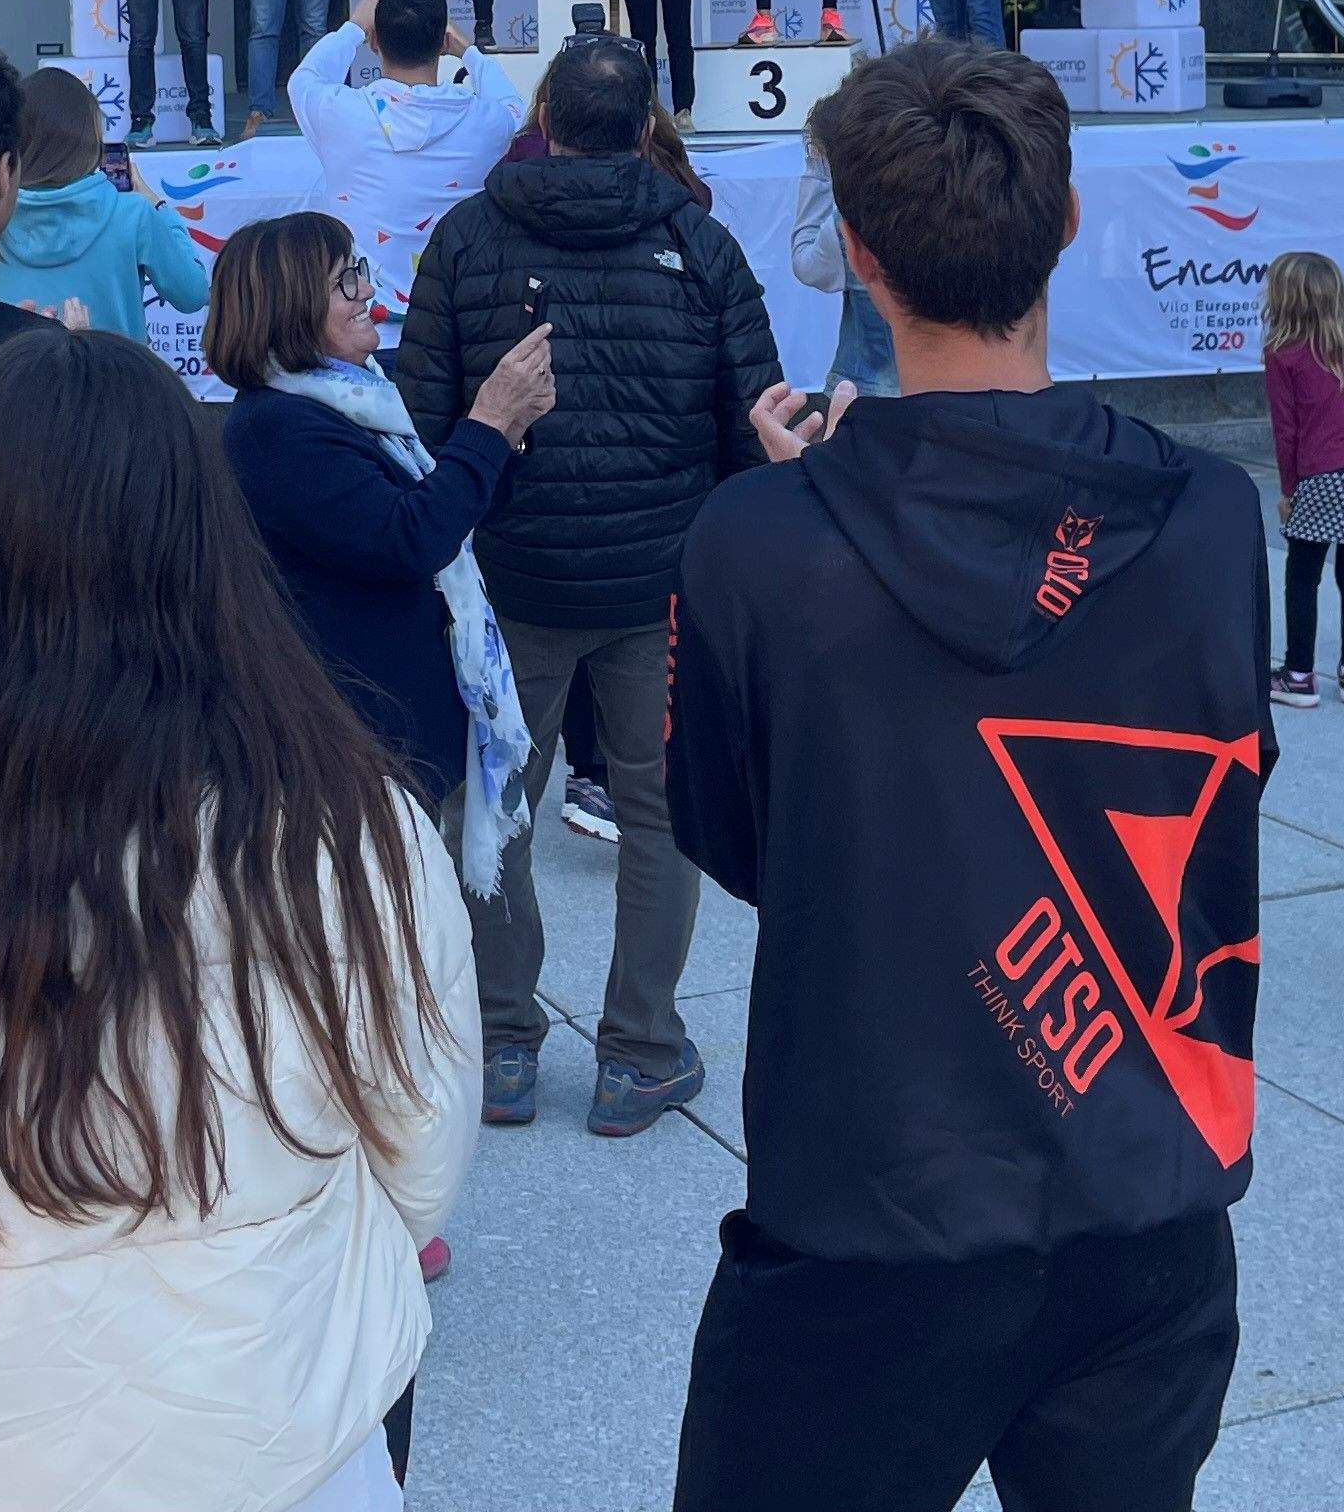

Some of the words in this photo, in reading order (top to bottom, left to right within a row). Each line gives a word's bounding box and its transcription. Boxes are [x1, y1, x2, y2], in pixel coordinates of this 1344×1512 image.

[748, 60, 788, 120] 3
[1141, 246, 1268, 291] Encam
[1159, 300, 1189, 313] Vila
[1169, 316, 1189, 329] de
[1191, 331, 1245, 351] 2020
[994, 896, 1124, 1095] OTSO
[966, 959, 1026, 1041] THINK
[1017, 1037, 1075, 1119] SPORT
